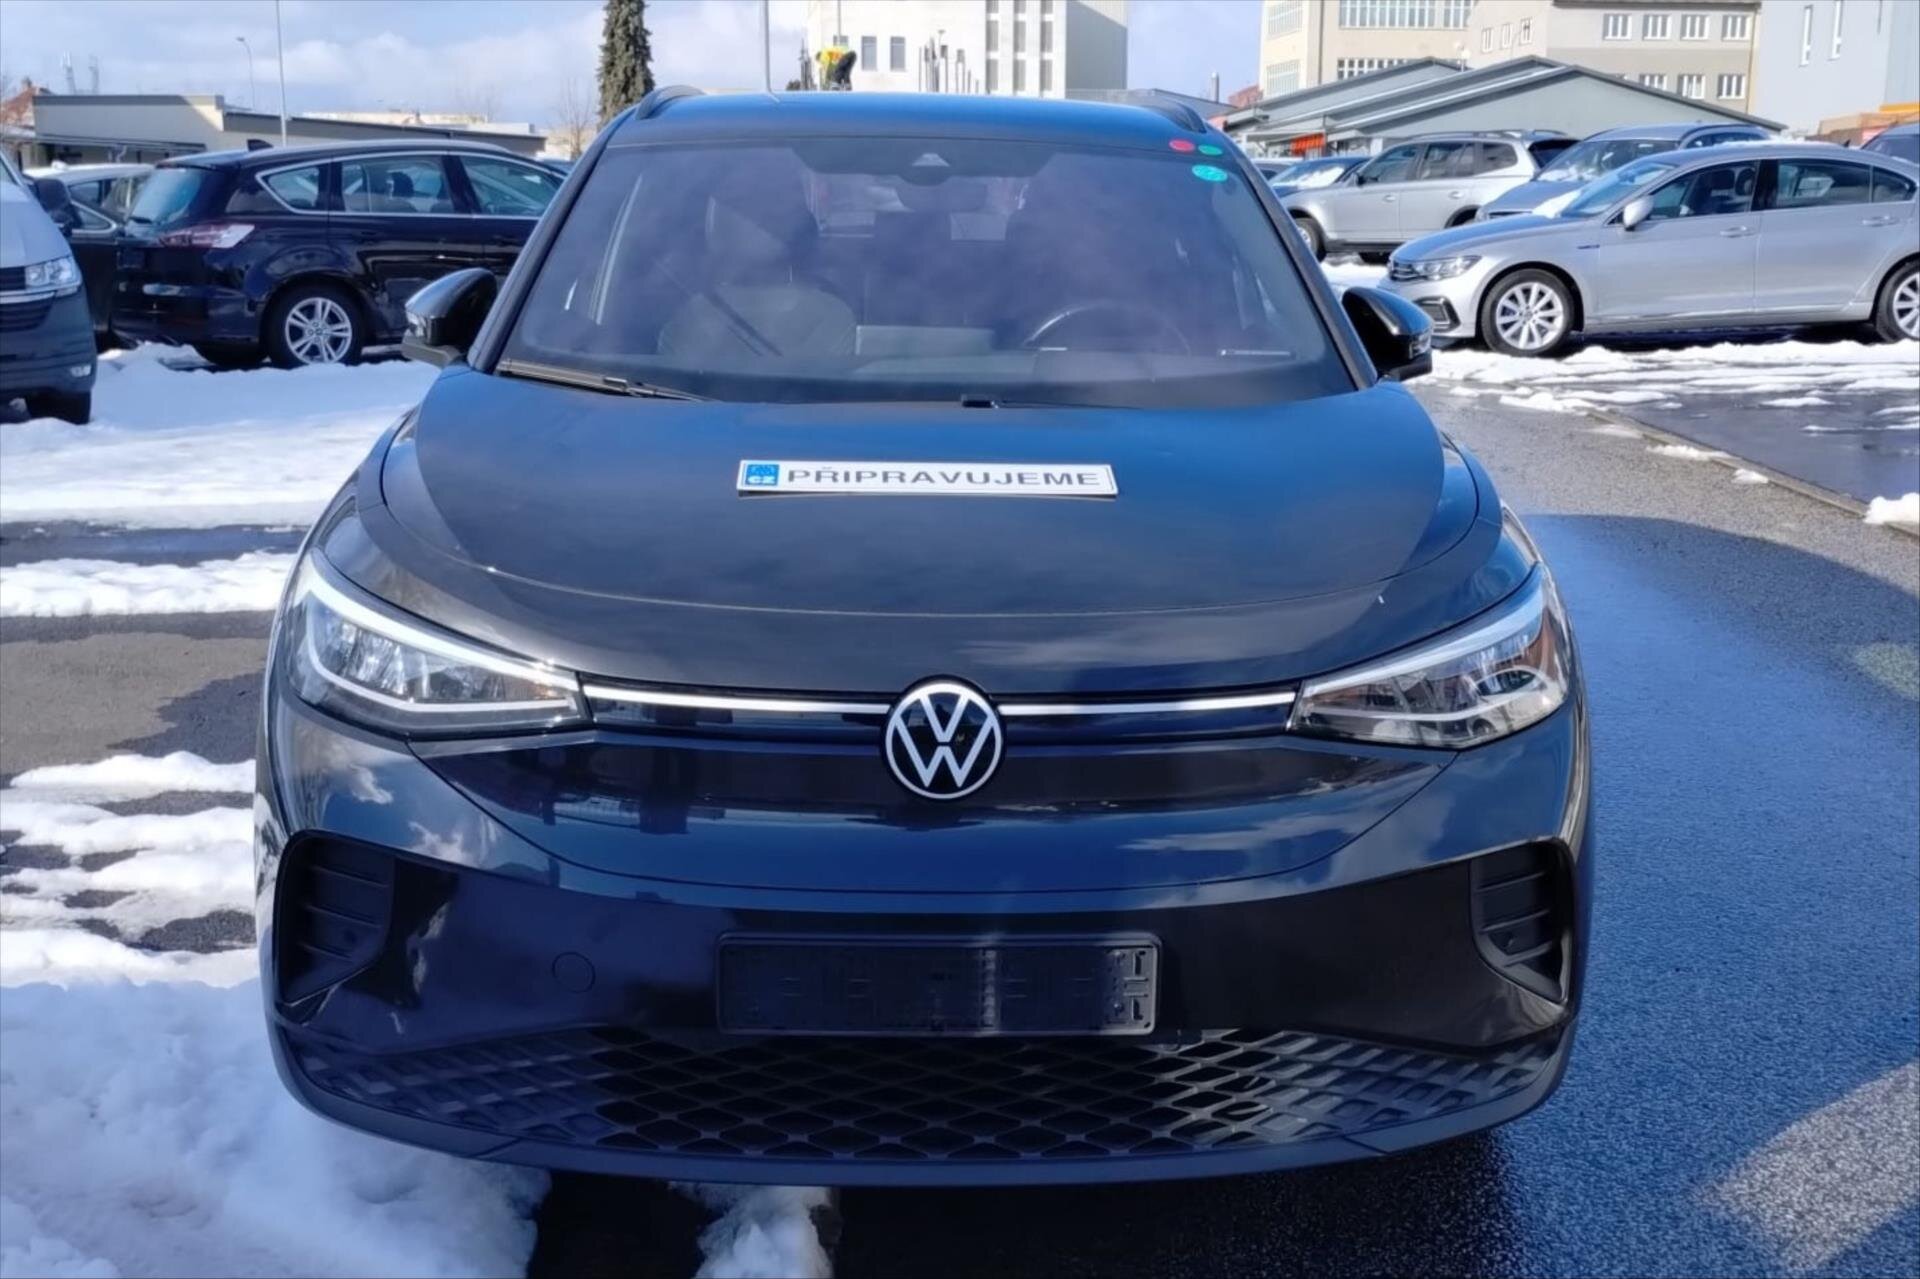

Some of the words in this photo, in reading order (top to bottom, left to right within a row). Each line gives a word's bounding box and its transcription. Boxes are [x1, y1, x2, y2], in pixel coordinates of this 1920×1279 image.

[747, 475, 776, 485] CZ
[788, 466, 1100, 486] PŘIPRAVUJEME
[890, 687, 997, 791] VW
